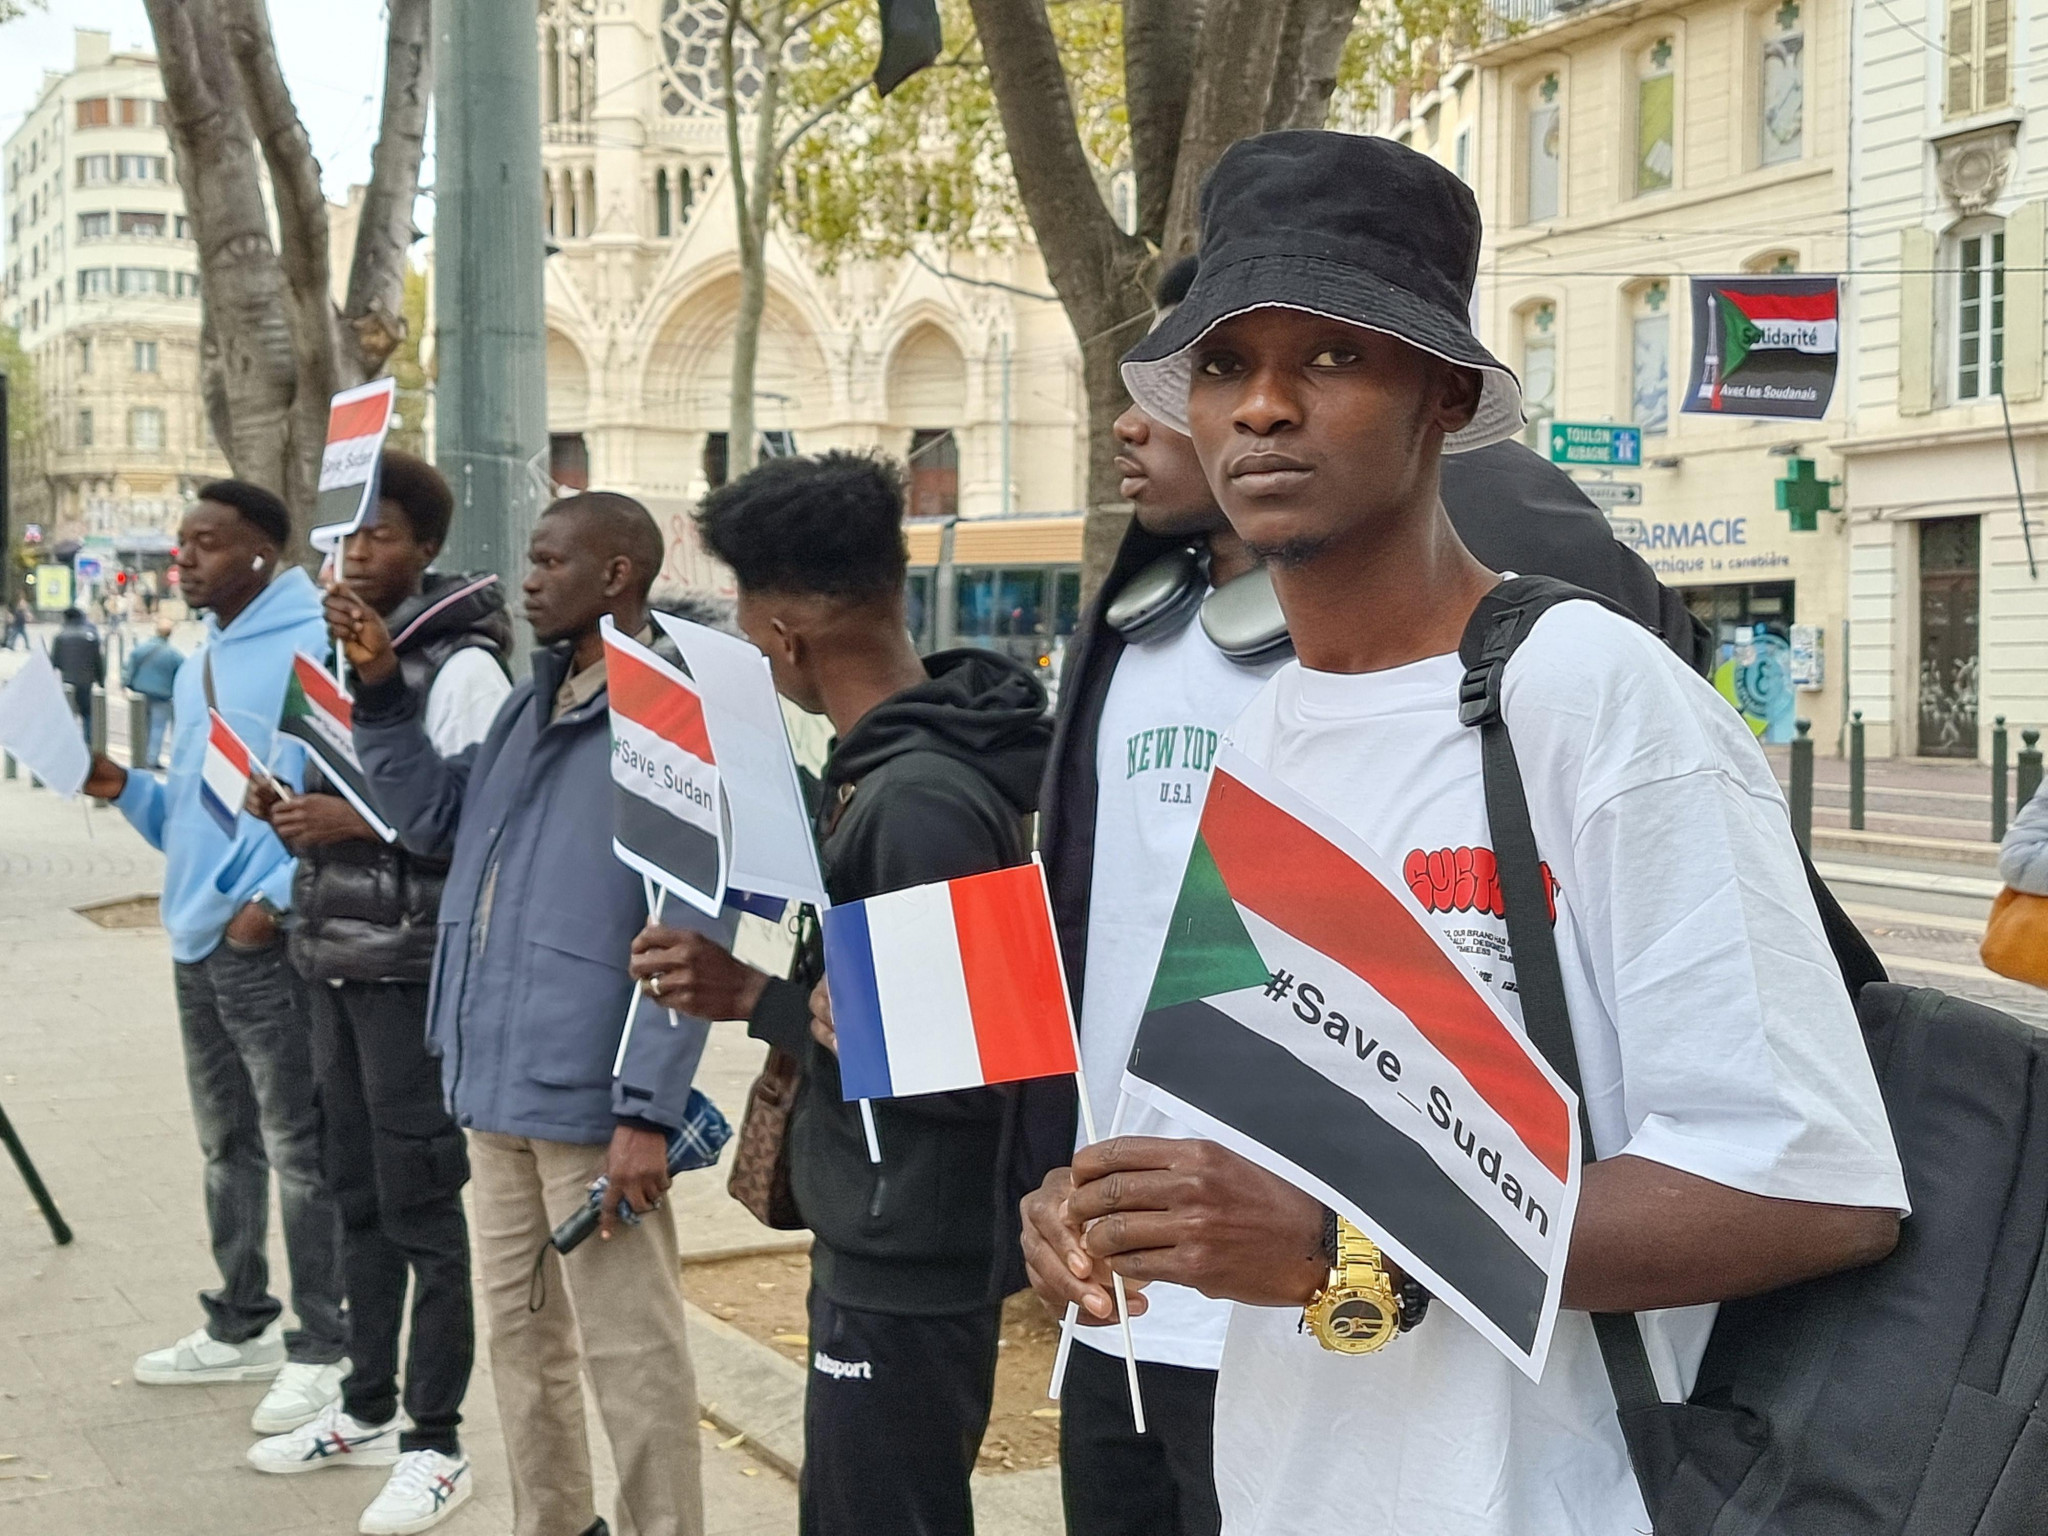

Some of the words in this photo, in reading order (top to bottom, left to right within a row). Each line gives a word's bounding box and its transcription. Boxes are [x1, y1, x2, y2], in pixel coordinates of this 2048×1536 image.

[1742, 326, 1818, 346] Solidarité
[1720, 383, 1745, 396] Avec
[1746, 385, 1762, 397] les
[1764, 385, 1818, 400] Soudanais
[1566, 427, 1610, 444] TOULON
[1633, 518, 1747, 550] ARMACIE
[1126, 726, 1179, 780] NEW
[1182, 724, 1219, 773] YOR
[613, 735, 714, 812] #Save_Sudan
[1160, 782, 1192, 804] U.S.A
[1453, 929, 1466, 937] OUR
[1467, 929, 1494, 941] BRAND
[1263, 967, 1550, 1238] #Save_Sudan
